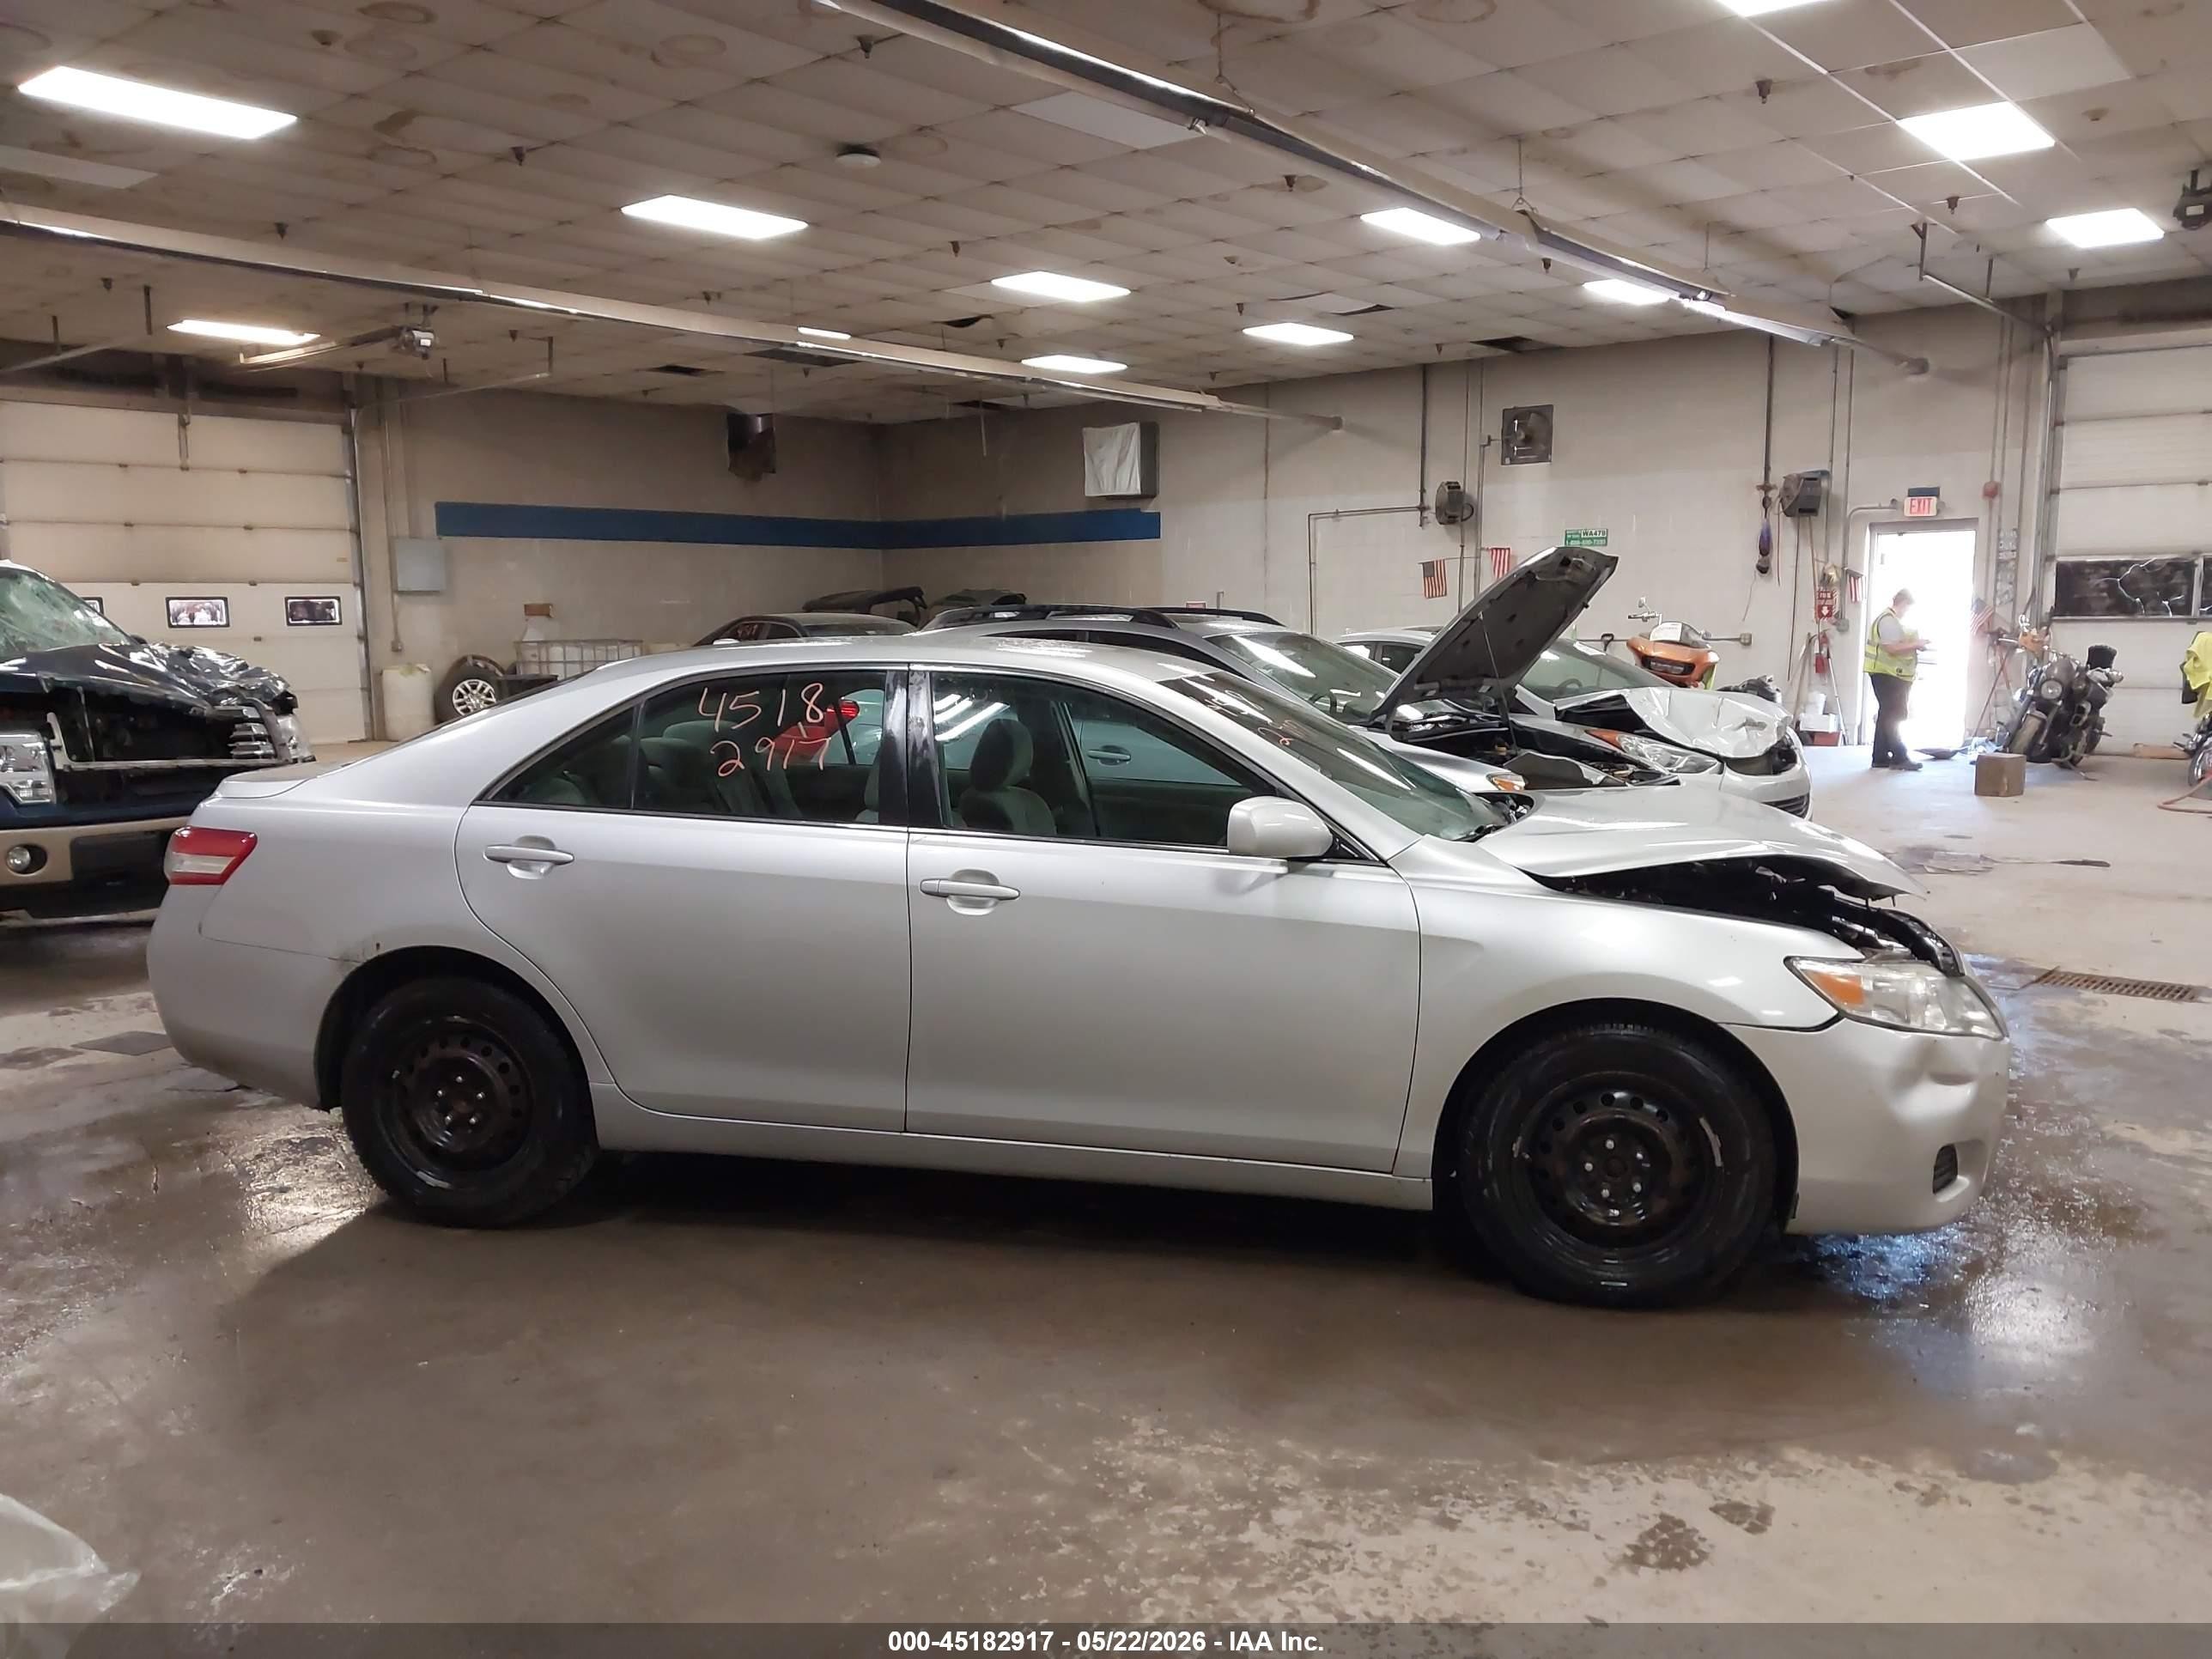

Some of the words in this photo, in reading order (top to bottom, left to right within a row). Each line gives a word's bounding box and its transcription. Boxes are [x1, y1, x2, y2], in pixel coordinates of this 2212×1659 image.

[1910, 498, 1932, 514] EXIT
[698, 682, 825, 732] 4518
[709, 736, 832, 777] 2917
